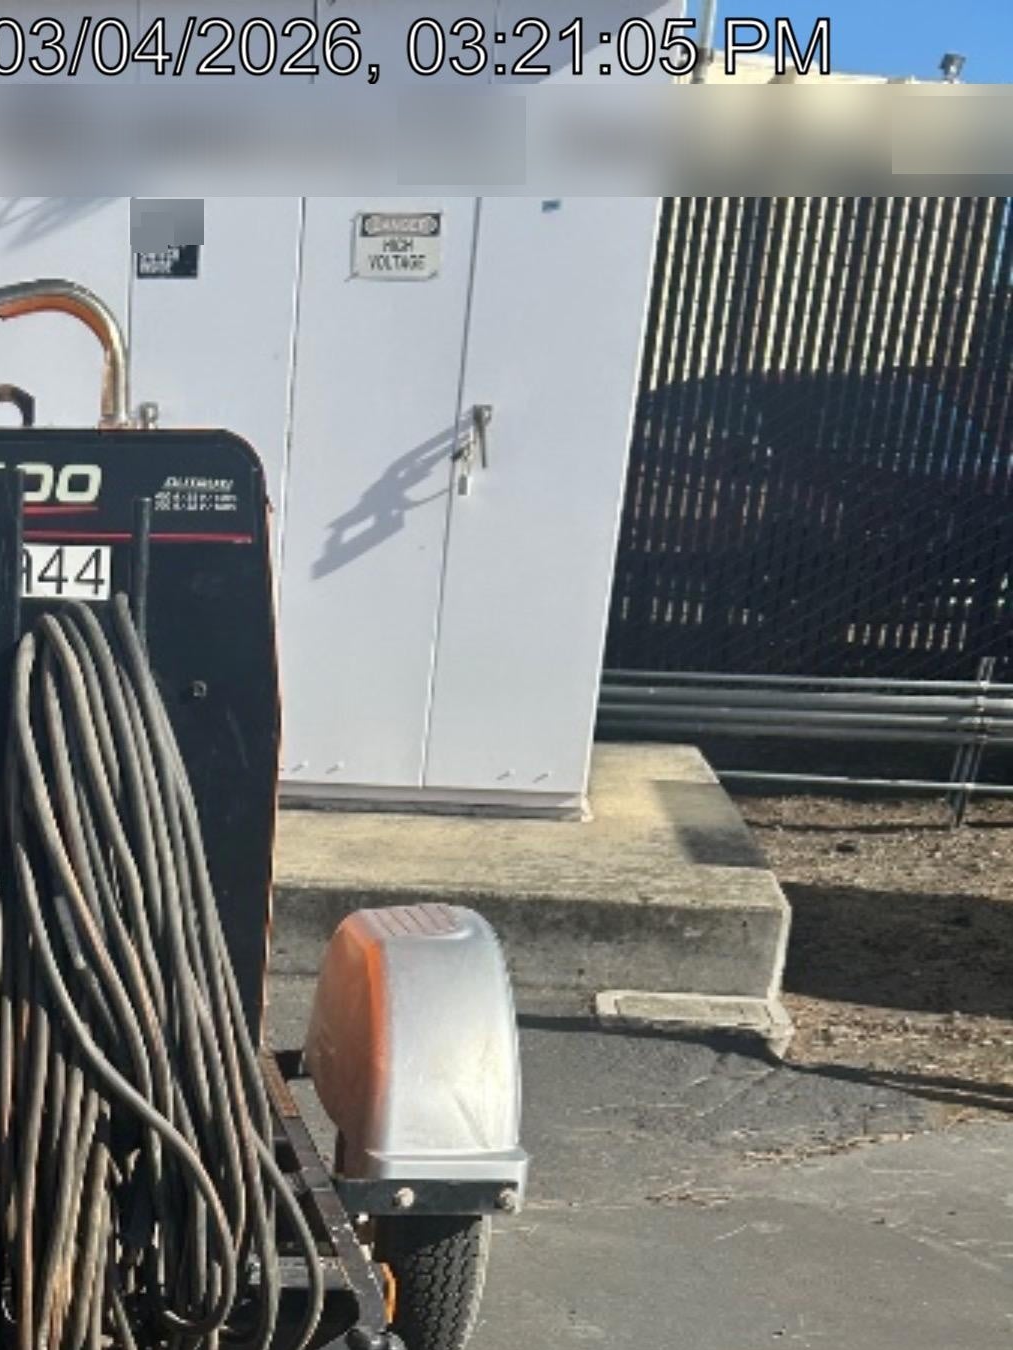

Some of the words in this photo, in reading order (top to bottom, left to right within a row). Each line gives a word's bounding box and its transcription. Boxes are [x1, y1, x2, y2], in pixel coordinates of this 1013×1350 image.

[368, 217, 431, 232] DANGER
[383, 238, 413, 252] HIGH
[368, 254, 427, 270] VOLTAGE
